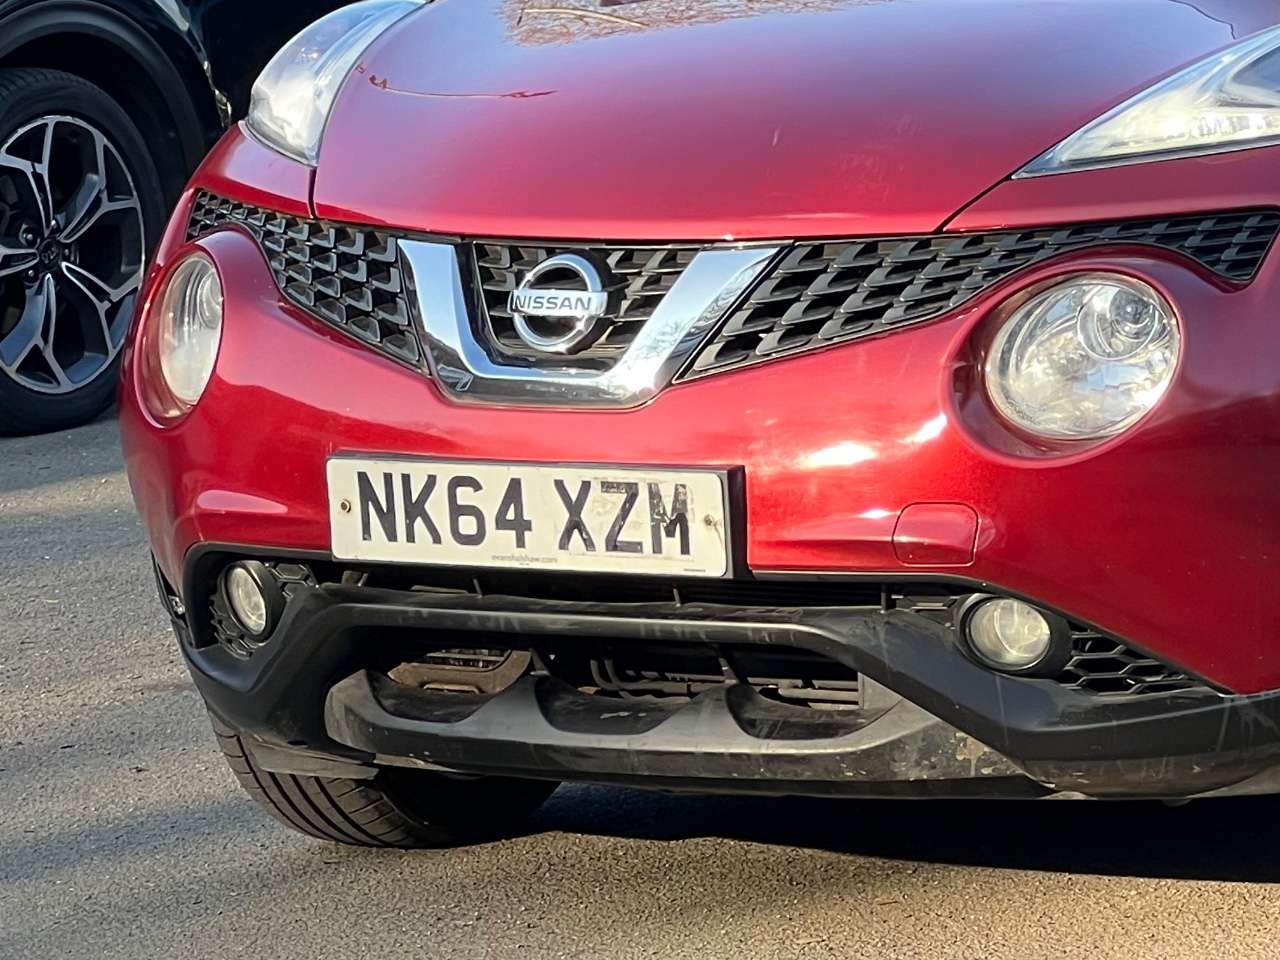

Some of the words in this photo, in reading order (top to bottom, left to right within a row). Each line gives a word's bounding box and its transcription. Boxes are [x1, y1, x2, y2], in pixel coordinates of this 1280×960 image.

[515, 295, 592, 311] NISSAN
[357, 471, 533, 549] NK64
[554, 478, 692, 556] XZM
